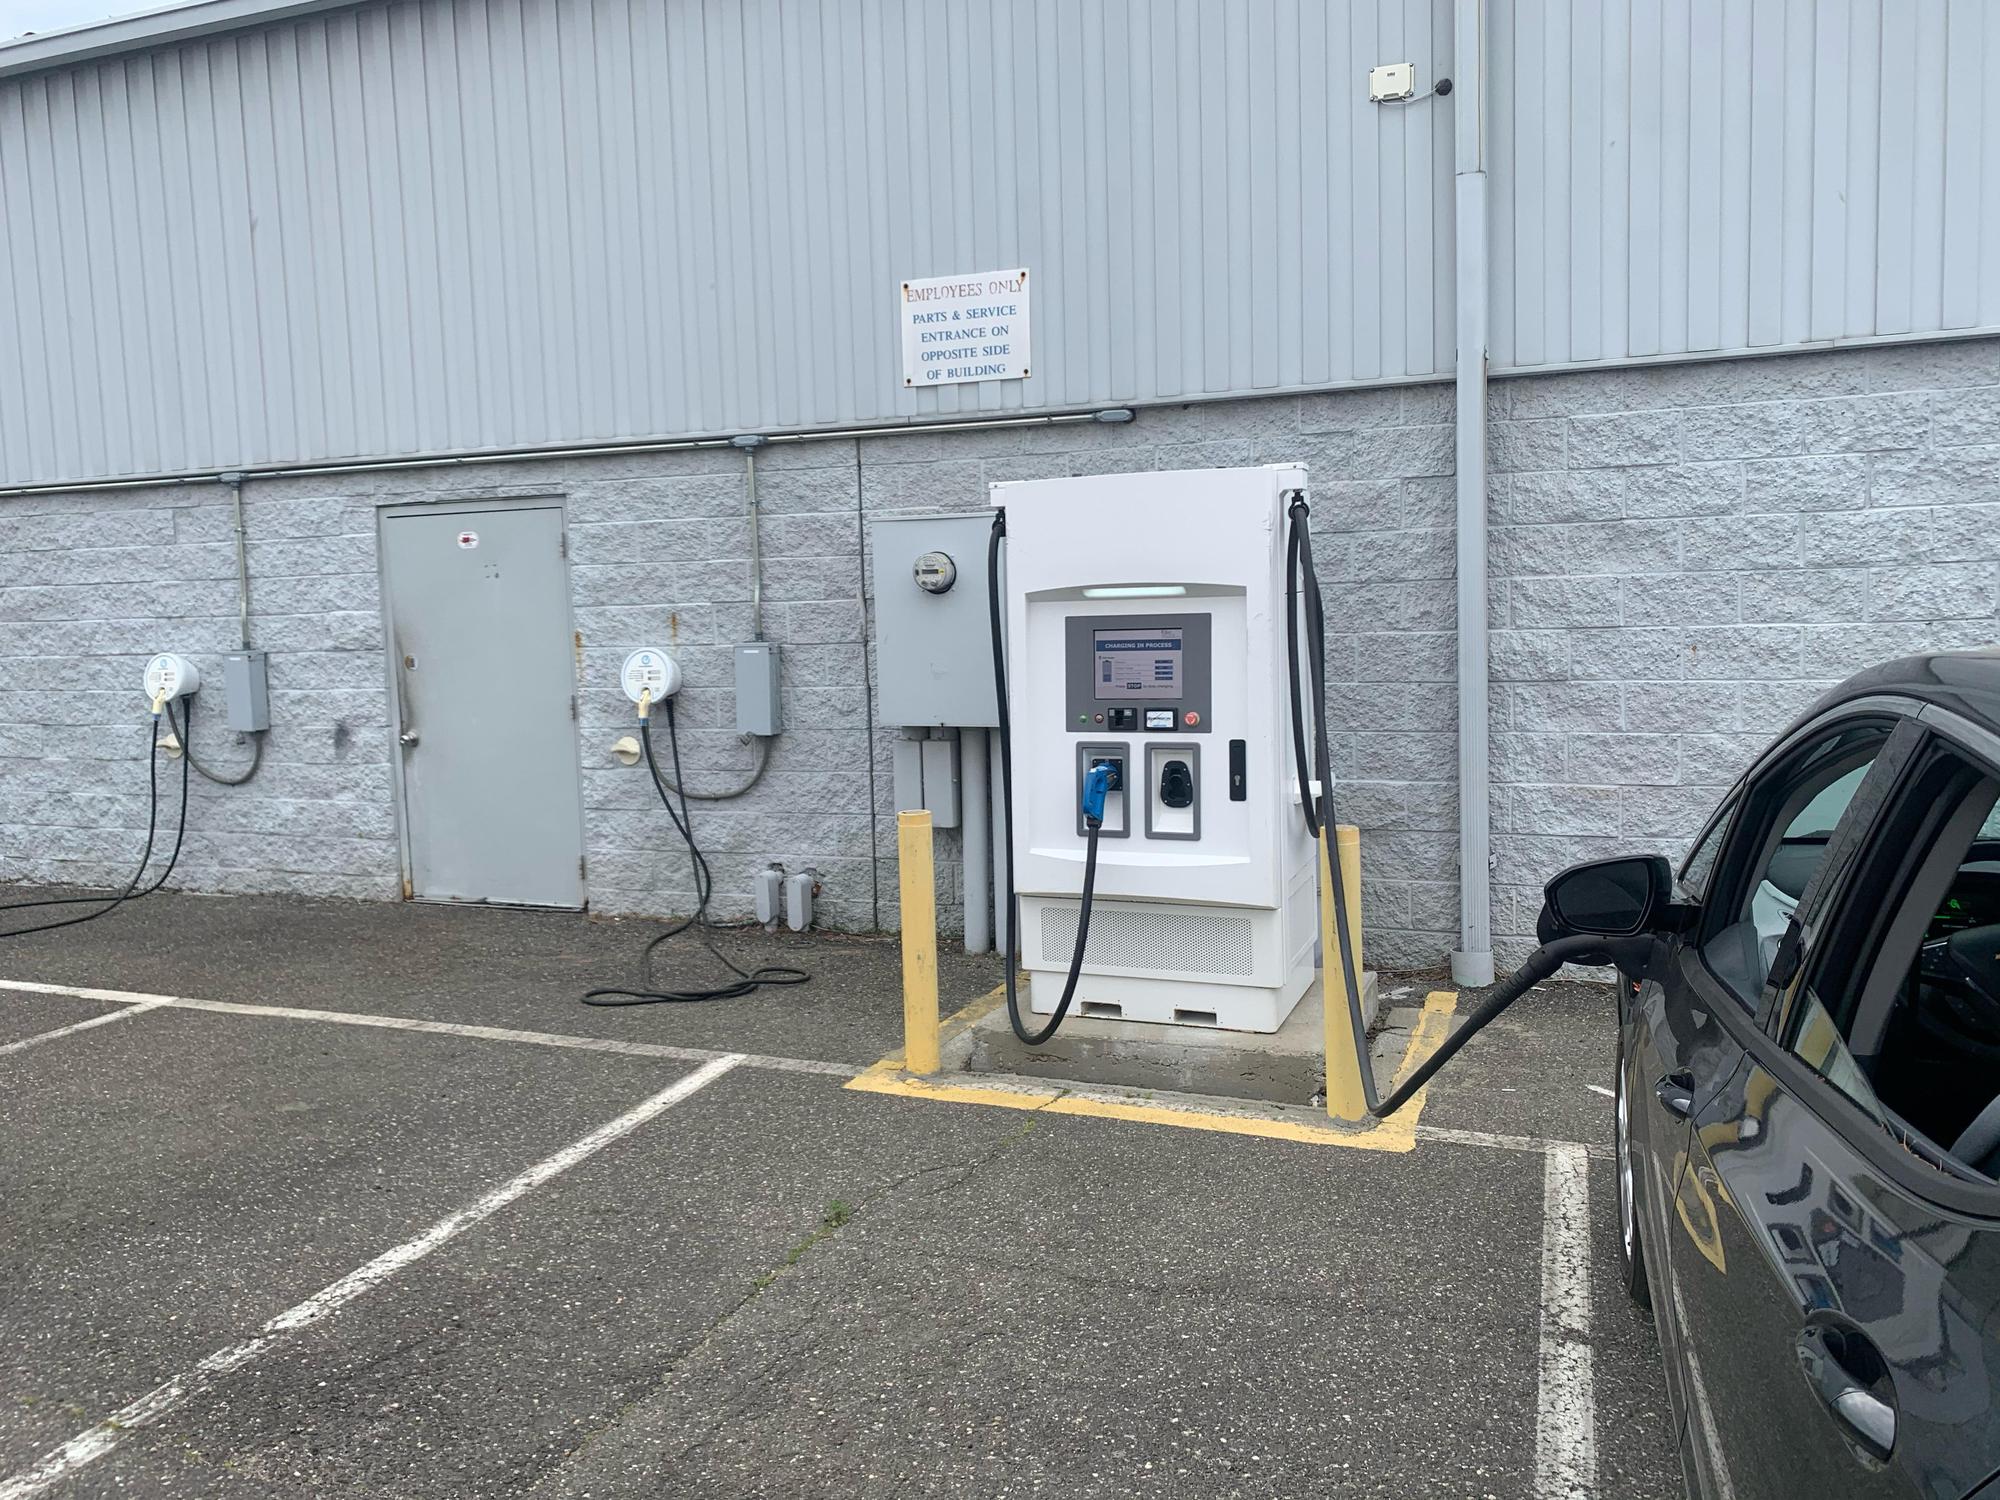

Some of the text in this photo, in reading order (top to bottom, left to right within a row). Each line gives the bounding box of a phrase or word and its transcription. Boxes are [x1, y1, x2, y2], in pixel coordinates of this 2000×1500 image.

[907, 280, 1023, 303] EMPLOYEES ONLY
[913, 305, 1017, 324] PARTS & SERVICE
[921, 325, 1009, 343] ENTRANCE ON
[921, 344, 1010, 362] OPPOSITE SIDE
[926, 363, 1006, 381] OF BUILDING
